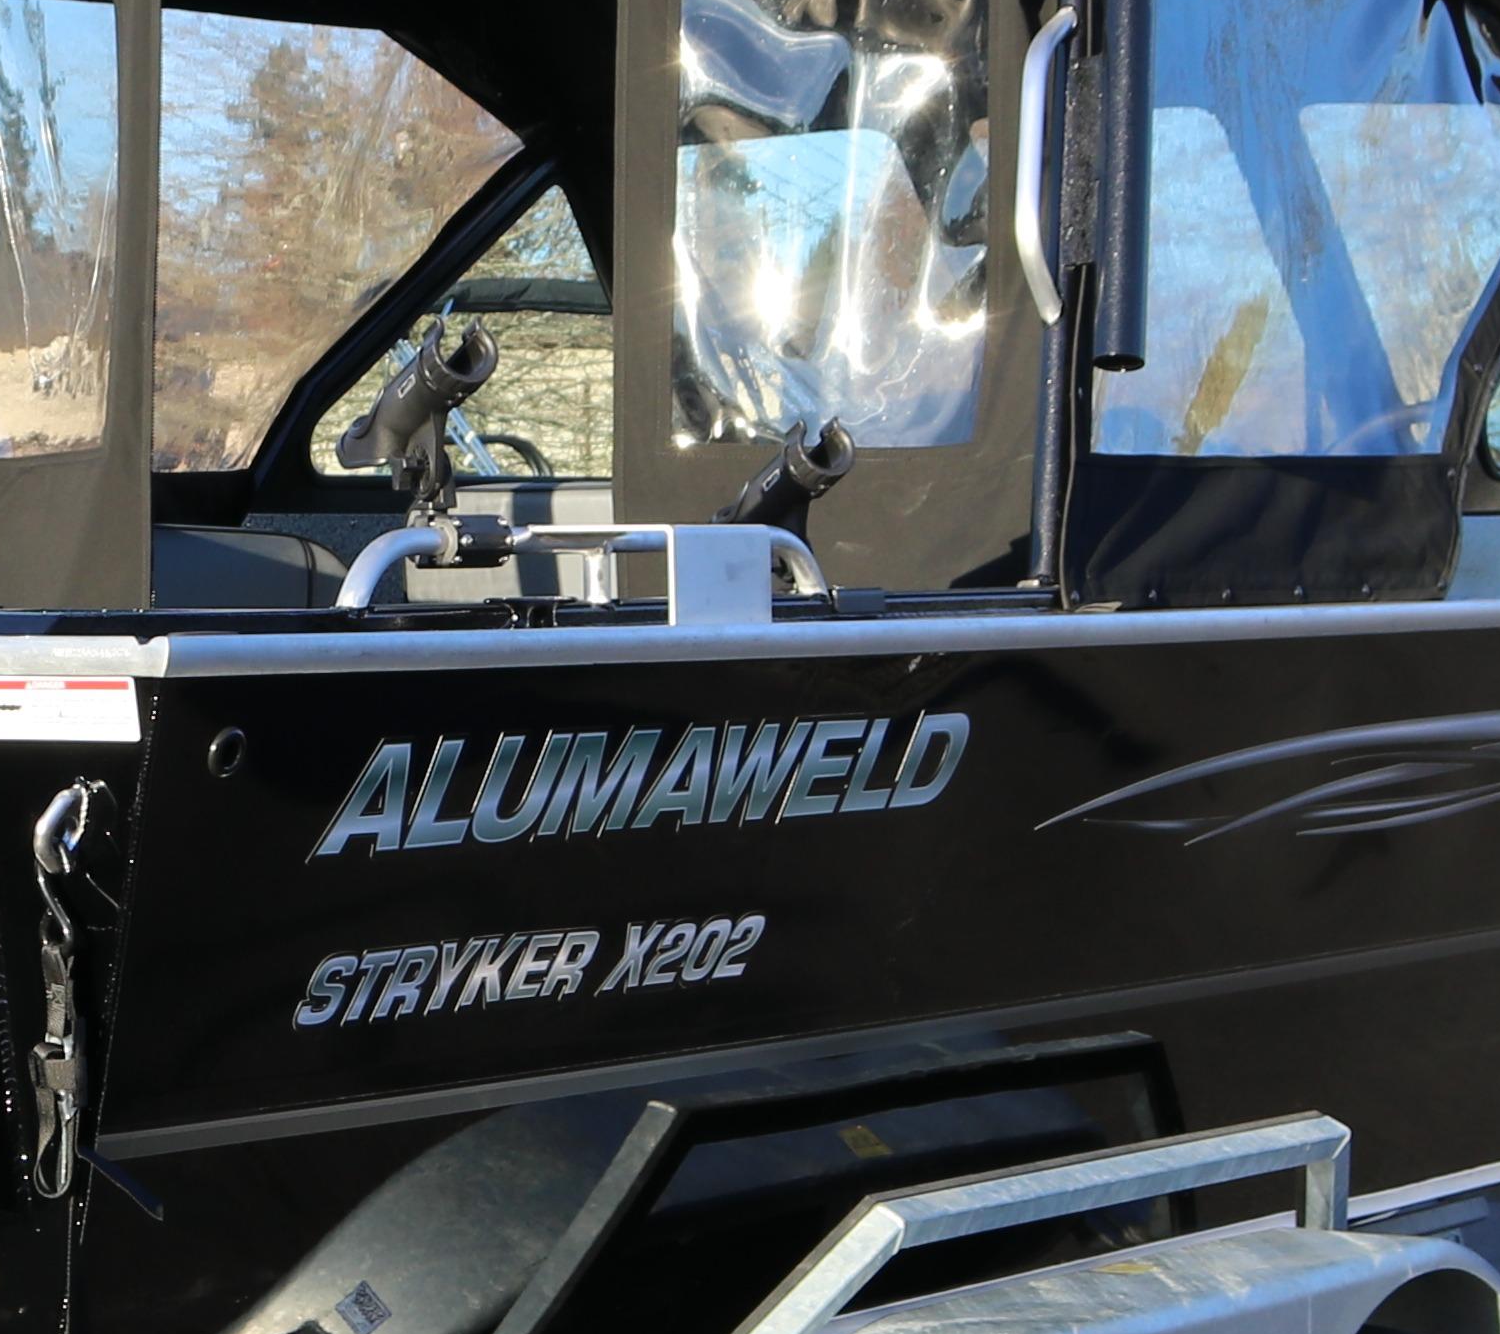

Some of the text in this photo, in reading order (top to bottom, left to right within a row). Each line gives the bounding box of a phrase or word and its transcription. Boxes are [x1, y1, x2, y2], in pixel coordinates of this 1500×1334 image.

[306, 710, 971, 864] ALUMAWELD
[294, 911, 766, 1028] STRYKER X202
